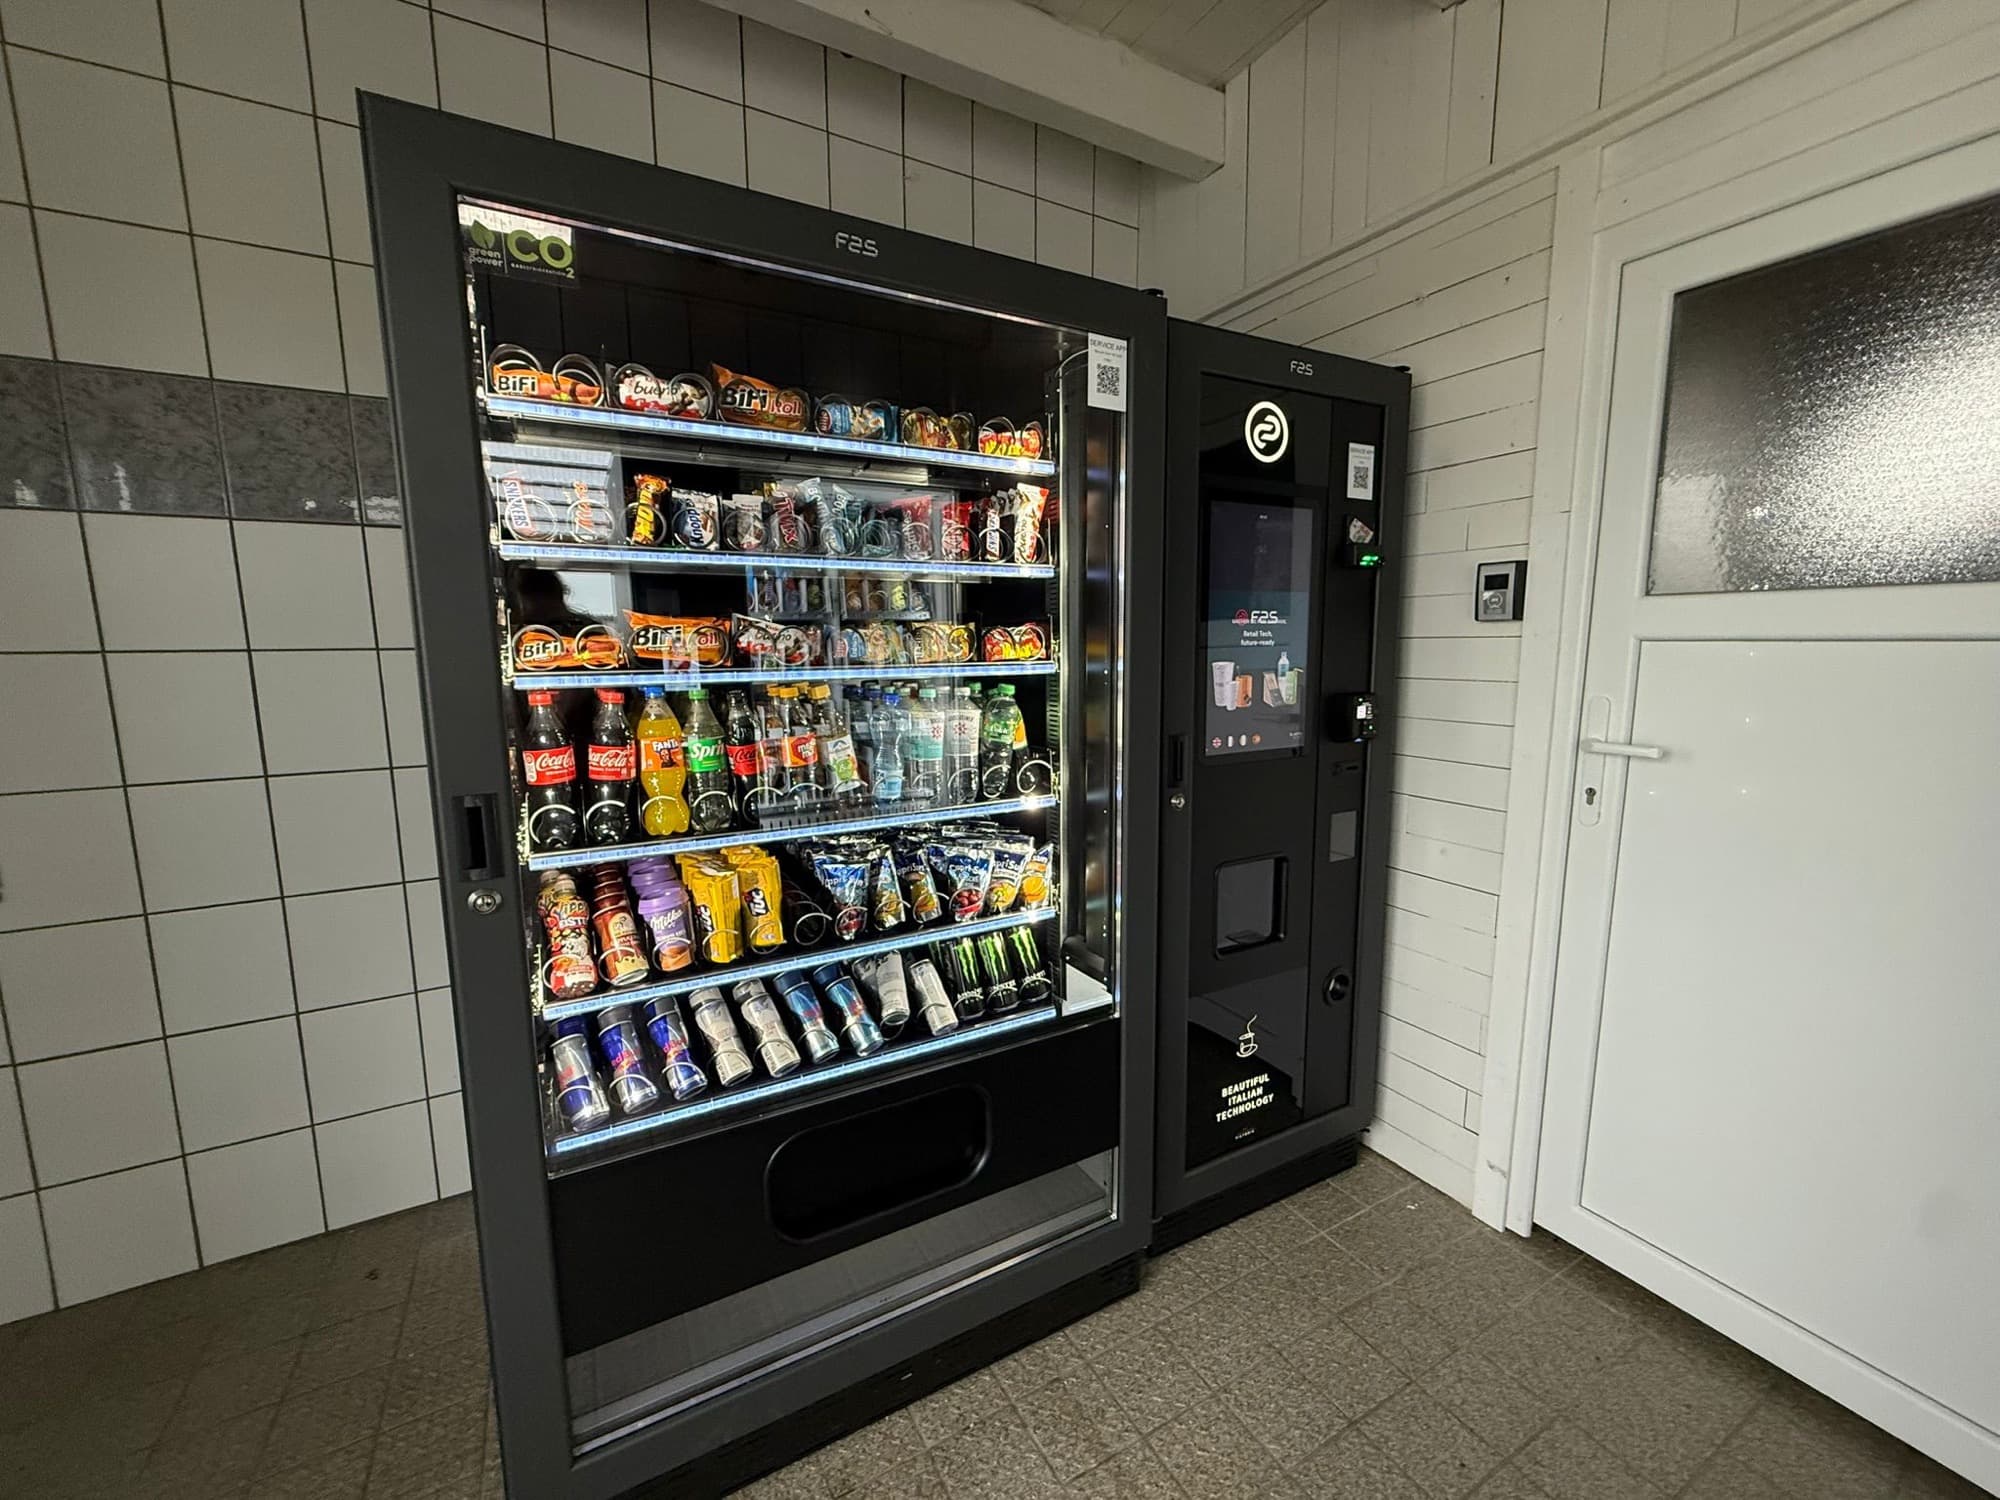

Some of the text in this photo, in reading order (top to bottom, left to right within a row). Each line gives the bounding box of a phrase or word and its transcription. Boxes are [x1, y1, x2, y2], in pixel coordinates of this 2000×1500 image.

[499, 376, 536, 392] BiFi
[698, 632, 718, 646] oll
[523, 641, 560, 659] BiFi
[650, 910, 683, 930] Milka
[1221, 1073, 1270, 1098] BEAUTIFUL
[1228, 1086, 1263, 1106] ITALIAN
[1216, 1093, 1274, 1122] TECHNOLOGY
